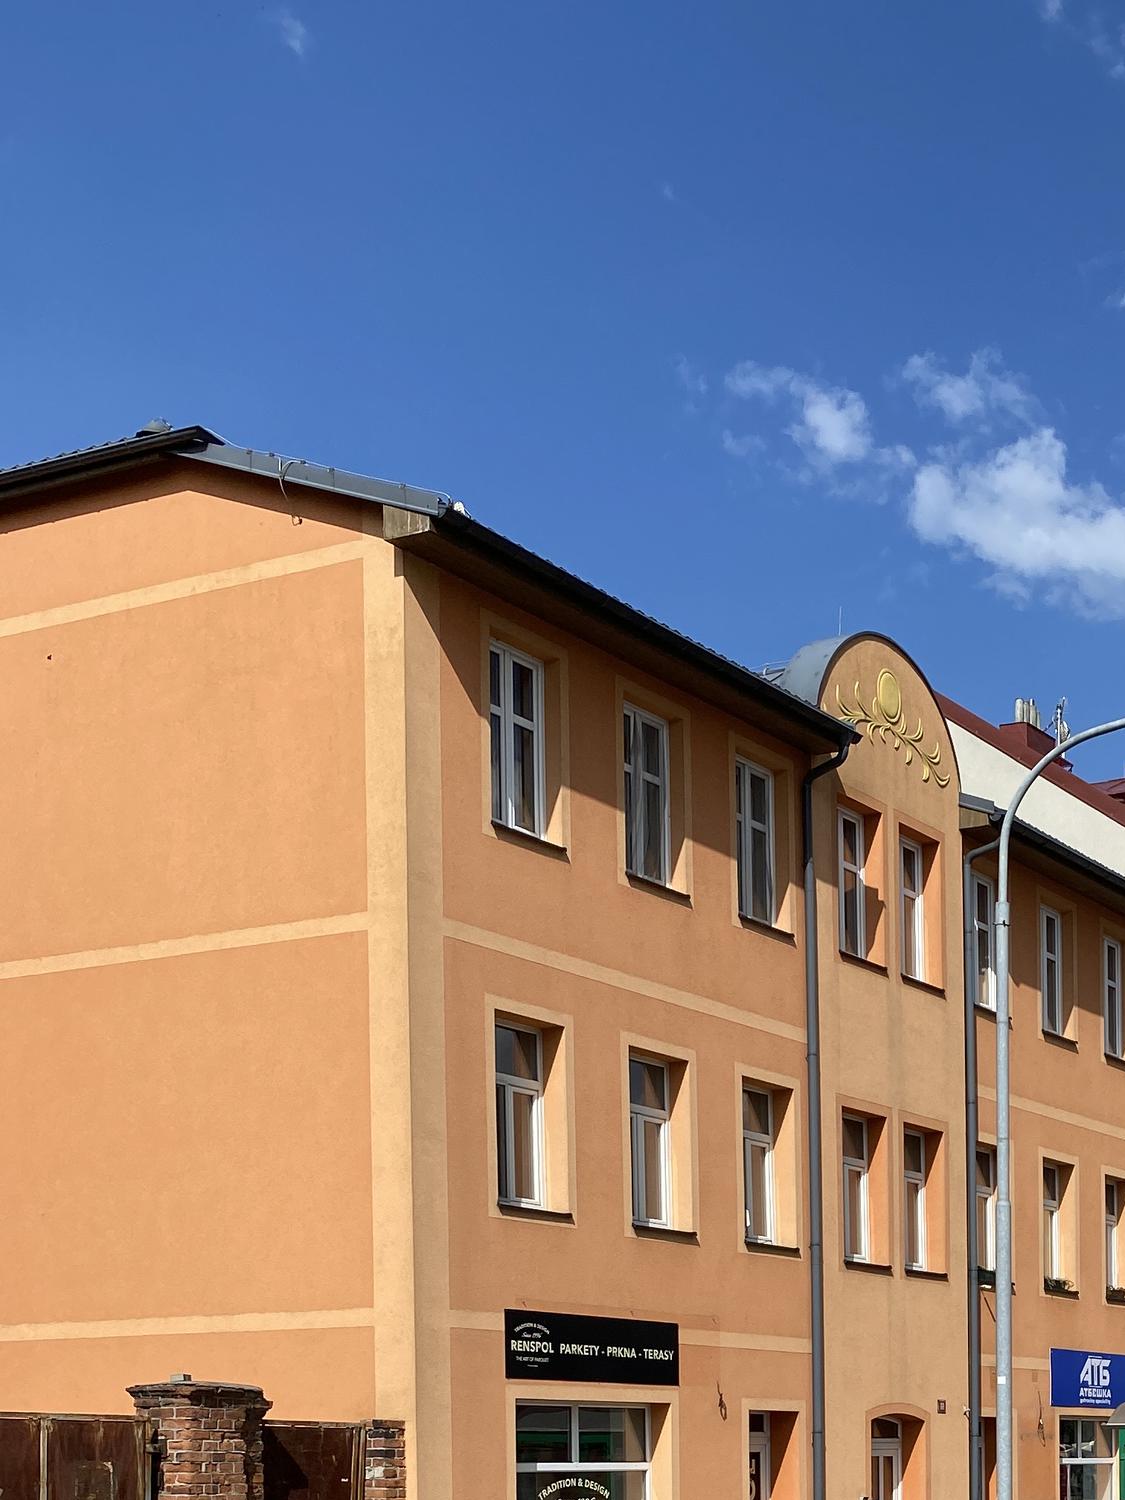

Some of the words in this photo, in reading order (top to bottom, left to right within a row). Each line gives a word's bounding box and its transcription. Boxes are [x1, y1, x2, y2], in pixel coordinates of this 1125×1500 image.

[510, 1339, 554, 1353] RENSPOL
[559, 1343, 600, 1356] PARKETY
[606, 1346, 637, 1359] PRKNA
[643, 1348, 674, 1361] TERASY
[537, 1478, 576, 1500] TRADITION
[577, 1478, 583, 1487] &
[584, 1479, 610, 1499] DESIGN
